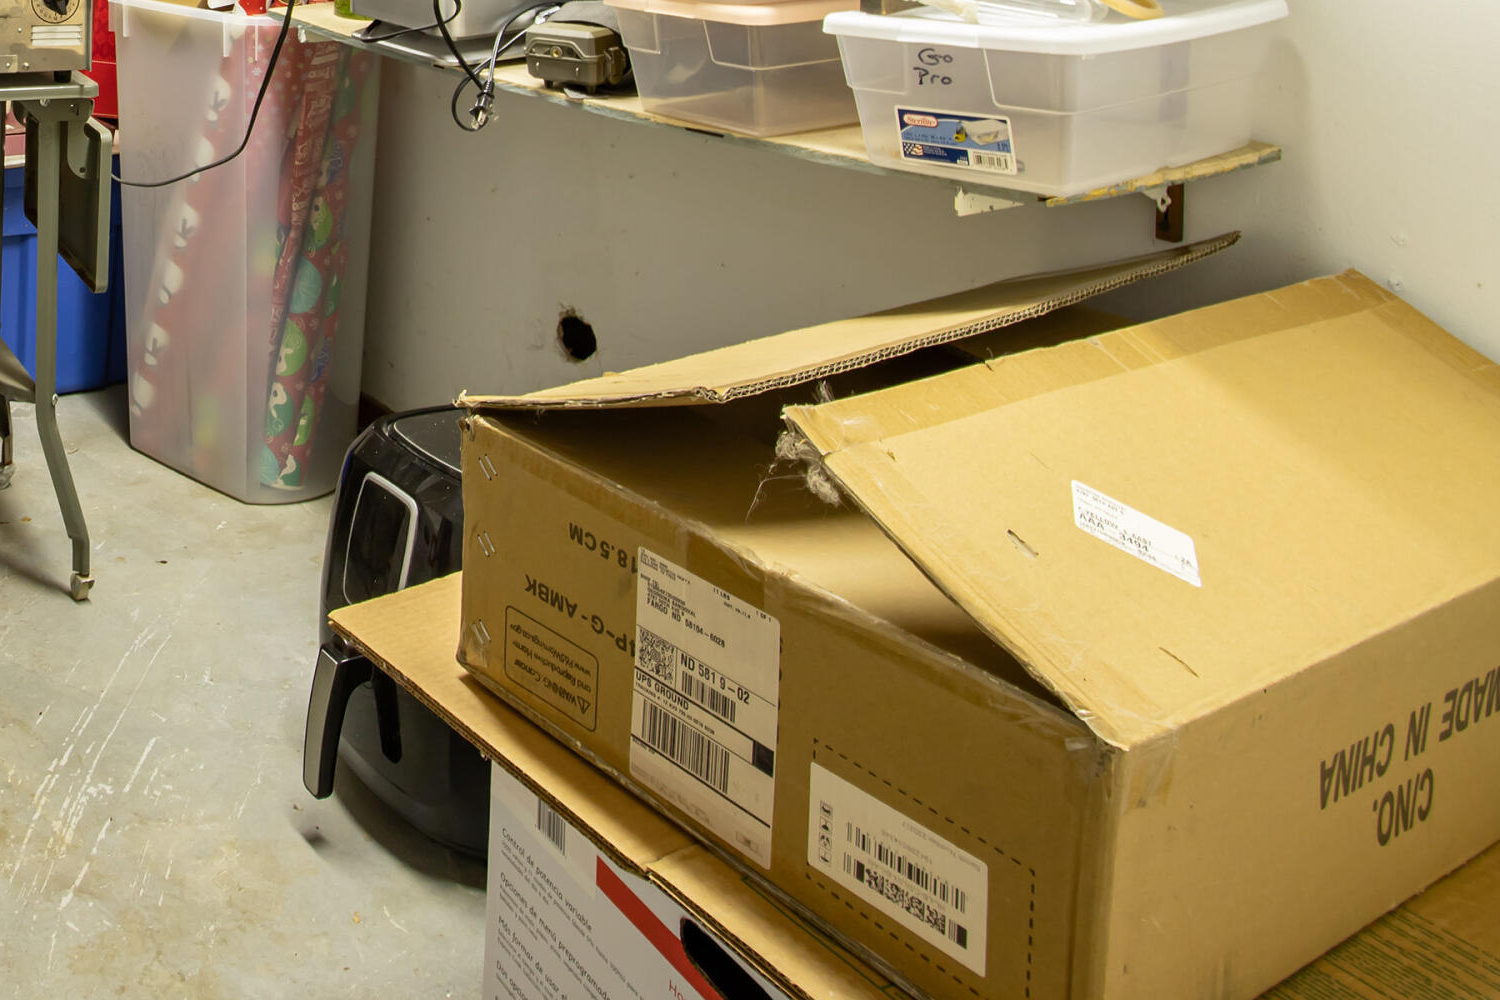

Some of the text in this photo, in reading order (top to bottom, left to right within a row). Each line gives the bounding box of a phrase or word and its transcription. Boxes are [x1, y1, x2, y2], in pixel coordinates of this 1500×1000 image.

[913, 67, 952, 85] Pro
[918, 48, 953, 65] Go
[647, 597, 667, 615] FARGO
[671, 611, 680, 622] ND
[635, 670, 688, 711] UPS GROUND
[680, 652, 749, 705] ND 581 9-02
[1319, 663, 1499, 811] MADE IN CHINA
[1372, 764, 1433, 852] C/NO.
[500, 871, 529, 909] Opciones
[529, 905, 537, 920] de
[502, 827, 592, 931] Control de potencia variable
[496, 959, 509, 981] Dos
[499, 918, 511, 936] Más
[535, 958, 543, 976] de
[544, 973, 560, 994] usar
